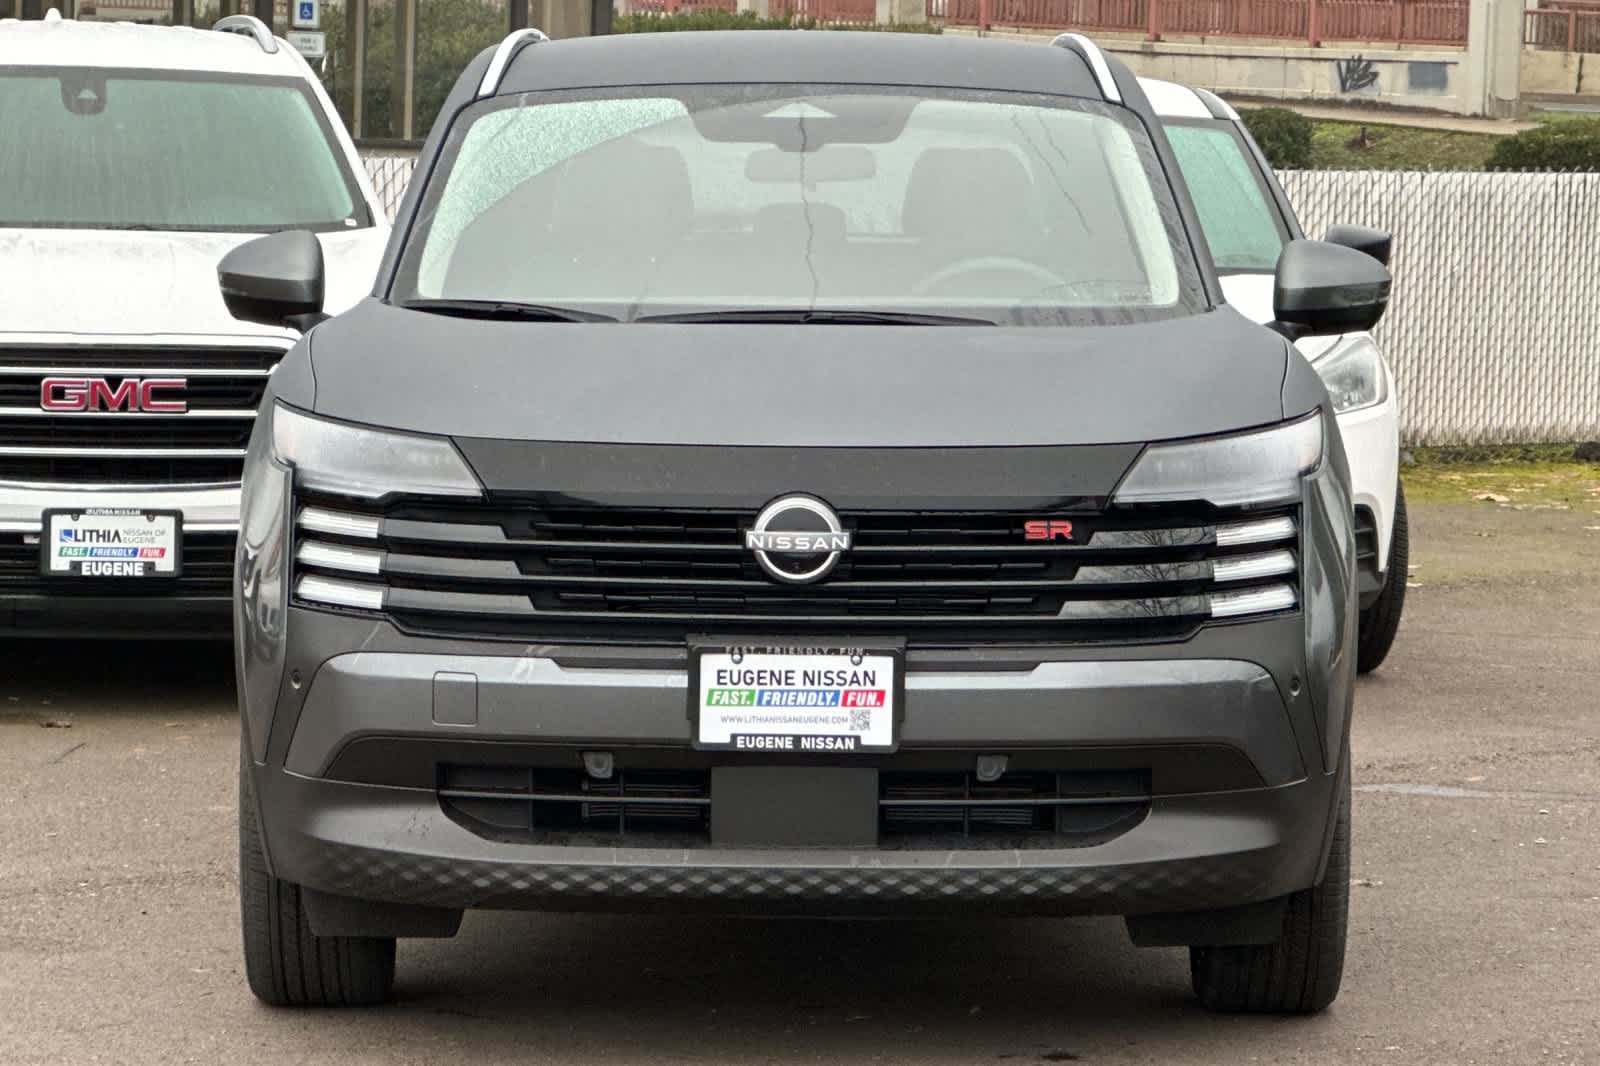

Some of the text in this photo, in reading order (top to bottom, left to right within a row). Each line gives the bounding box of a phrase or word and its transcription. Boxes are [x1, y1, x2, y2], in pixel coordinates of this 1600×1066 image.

[41, 377, 188, 412] GMC
[74, 529, 122, 543] LITHIA
[122, 529, 153, 537] NISSAN
[1024, 520, 1072, 540] SR
[748, 534, 847, 550] NISSAN
[81, 562, 144, 576] EUGENE
[717, 669, 876, 687] EUGENE NISSAN
[712, 690, 881, 706] FAST. FRIENDLY. FUN.
[736, 736, 855, 750] EUGENE NISSAN
